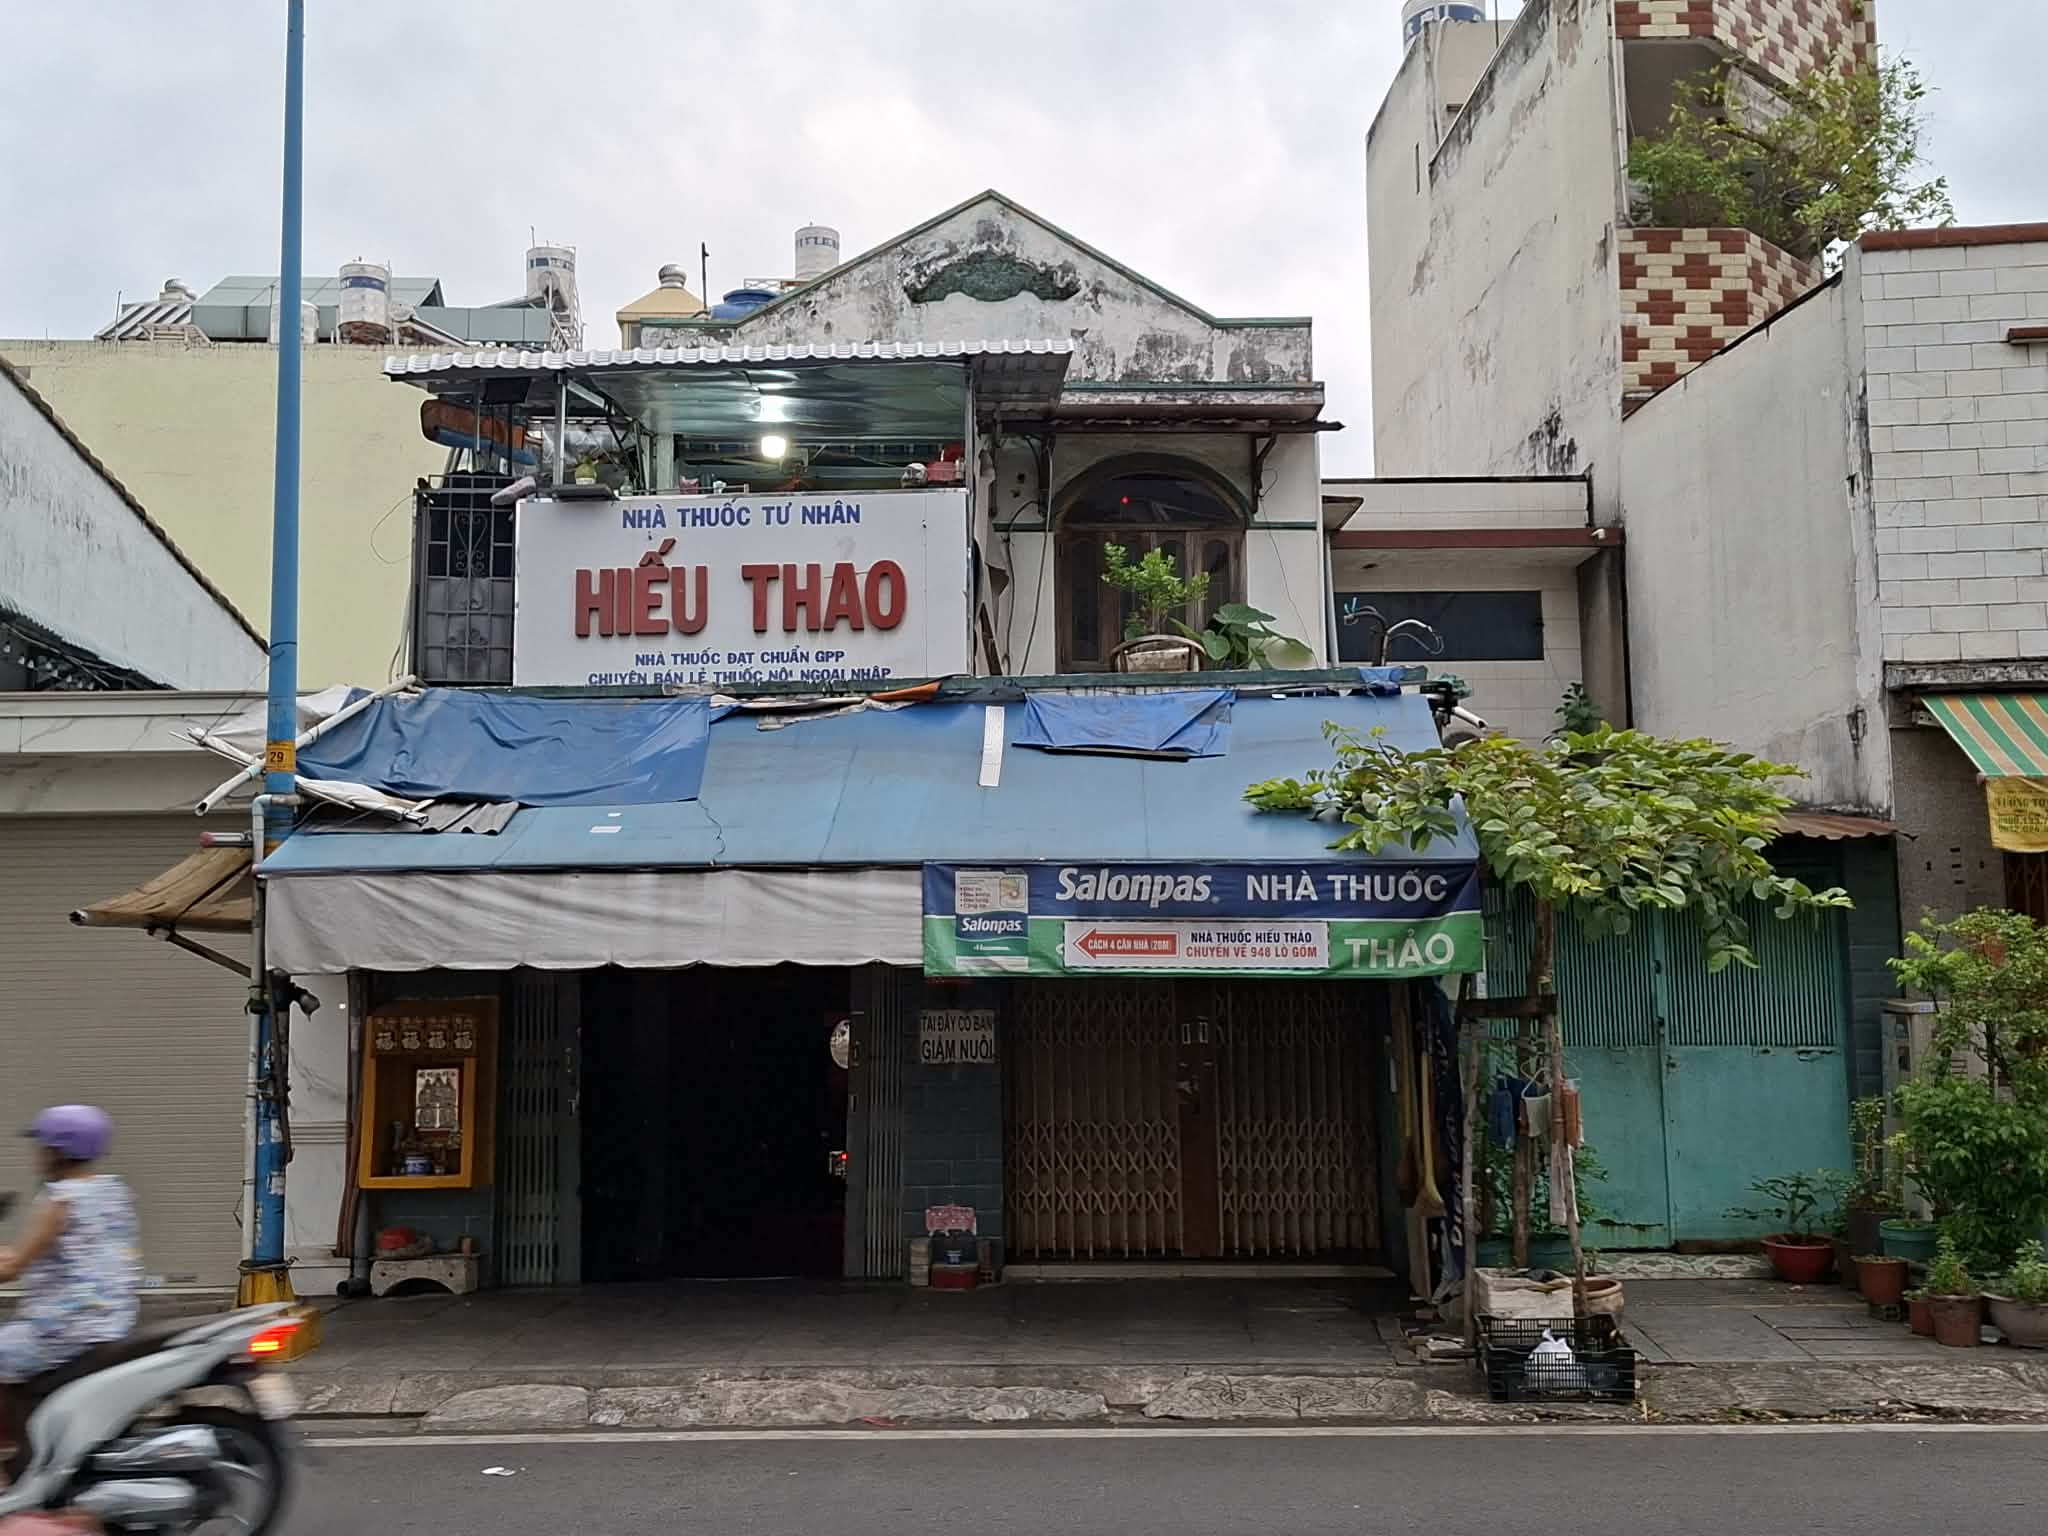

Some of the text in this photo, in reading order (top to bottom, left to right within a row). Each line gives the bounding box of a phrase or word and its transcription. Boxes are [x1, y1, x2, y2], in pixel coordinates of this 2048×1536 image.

[622, 498, 860, 529] NHÀ THUỐC TƯ NHÂN
[575, 538, 708, 637] HIẾU
[635, 645, 845, 667] NHÀ THUỐC ĐẠT CHUẨN GPP
[1056, 867, 1448, 909] Salonpas NHÀ THUỐC
[961, 917, 1021, 934] Salonpas
[1190, 930, 1212, 943] NHÀ
[1216, 928, 1252, 944] THUỐC
[1255, 928, 1280, 943] HIẾU
[1250, 946, 1271, 958] 948
[1344, 928, 1455, 969] THẢO
